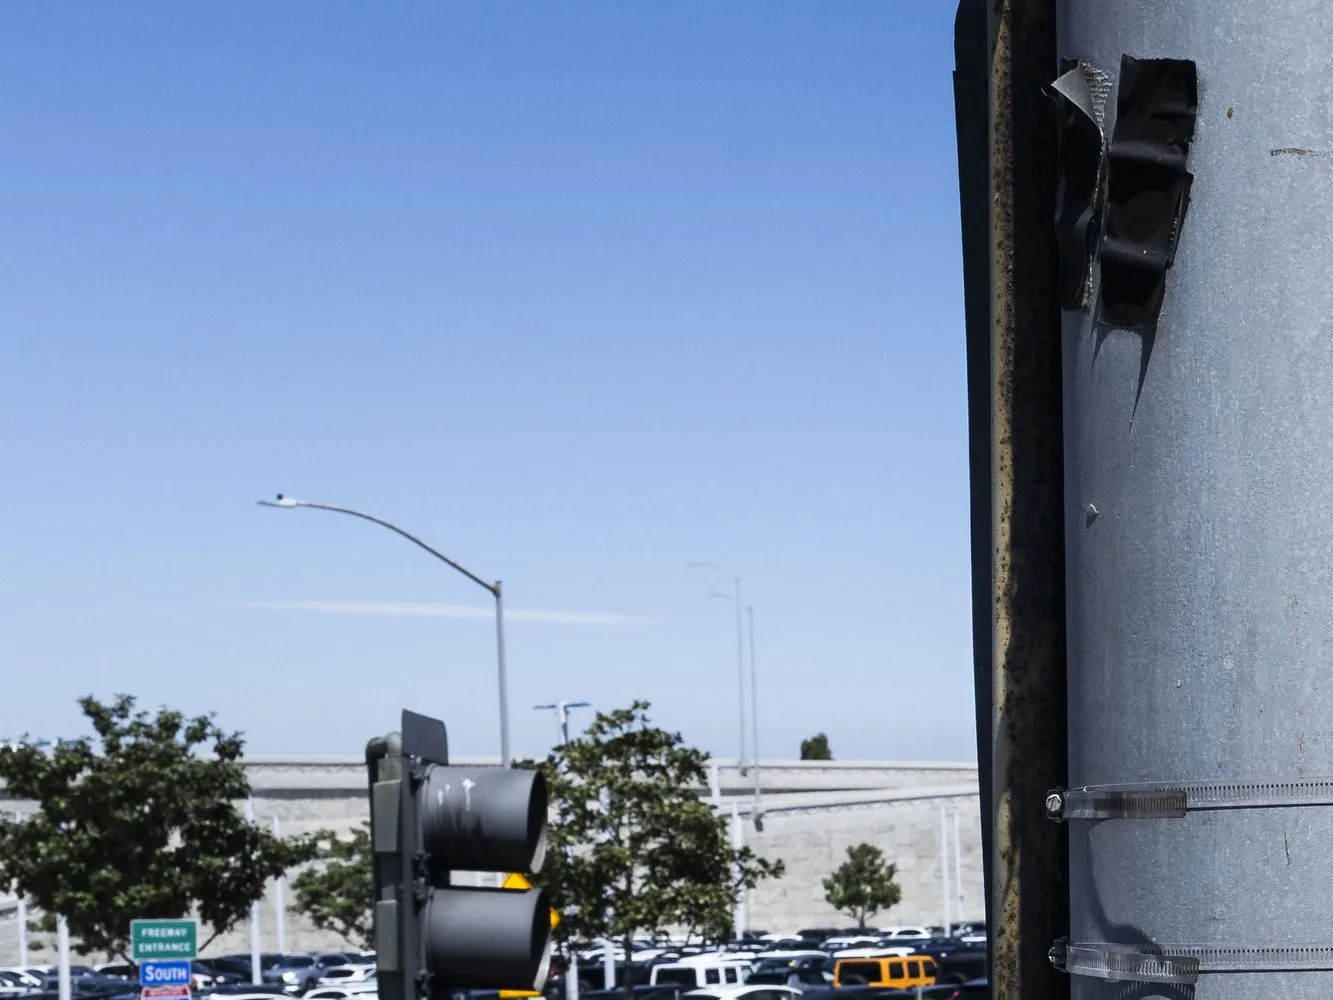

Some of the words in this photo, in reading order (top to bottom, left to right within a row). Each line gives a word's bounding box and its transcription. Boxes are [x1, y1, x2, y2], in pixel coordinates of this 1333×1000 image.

[141, 927, 188, 938] FREEWAY
[139, 942, 192, 953] ENTRANCE
[145, 965, 187, 981] SOUTH
